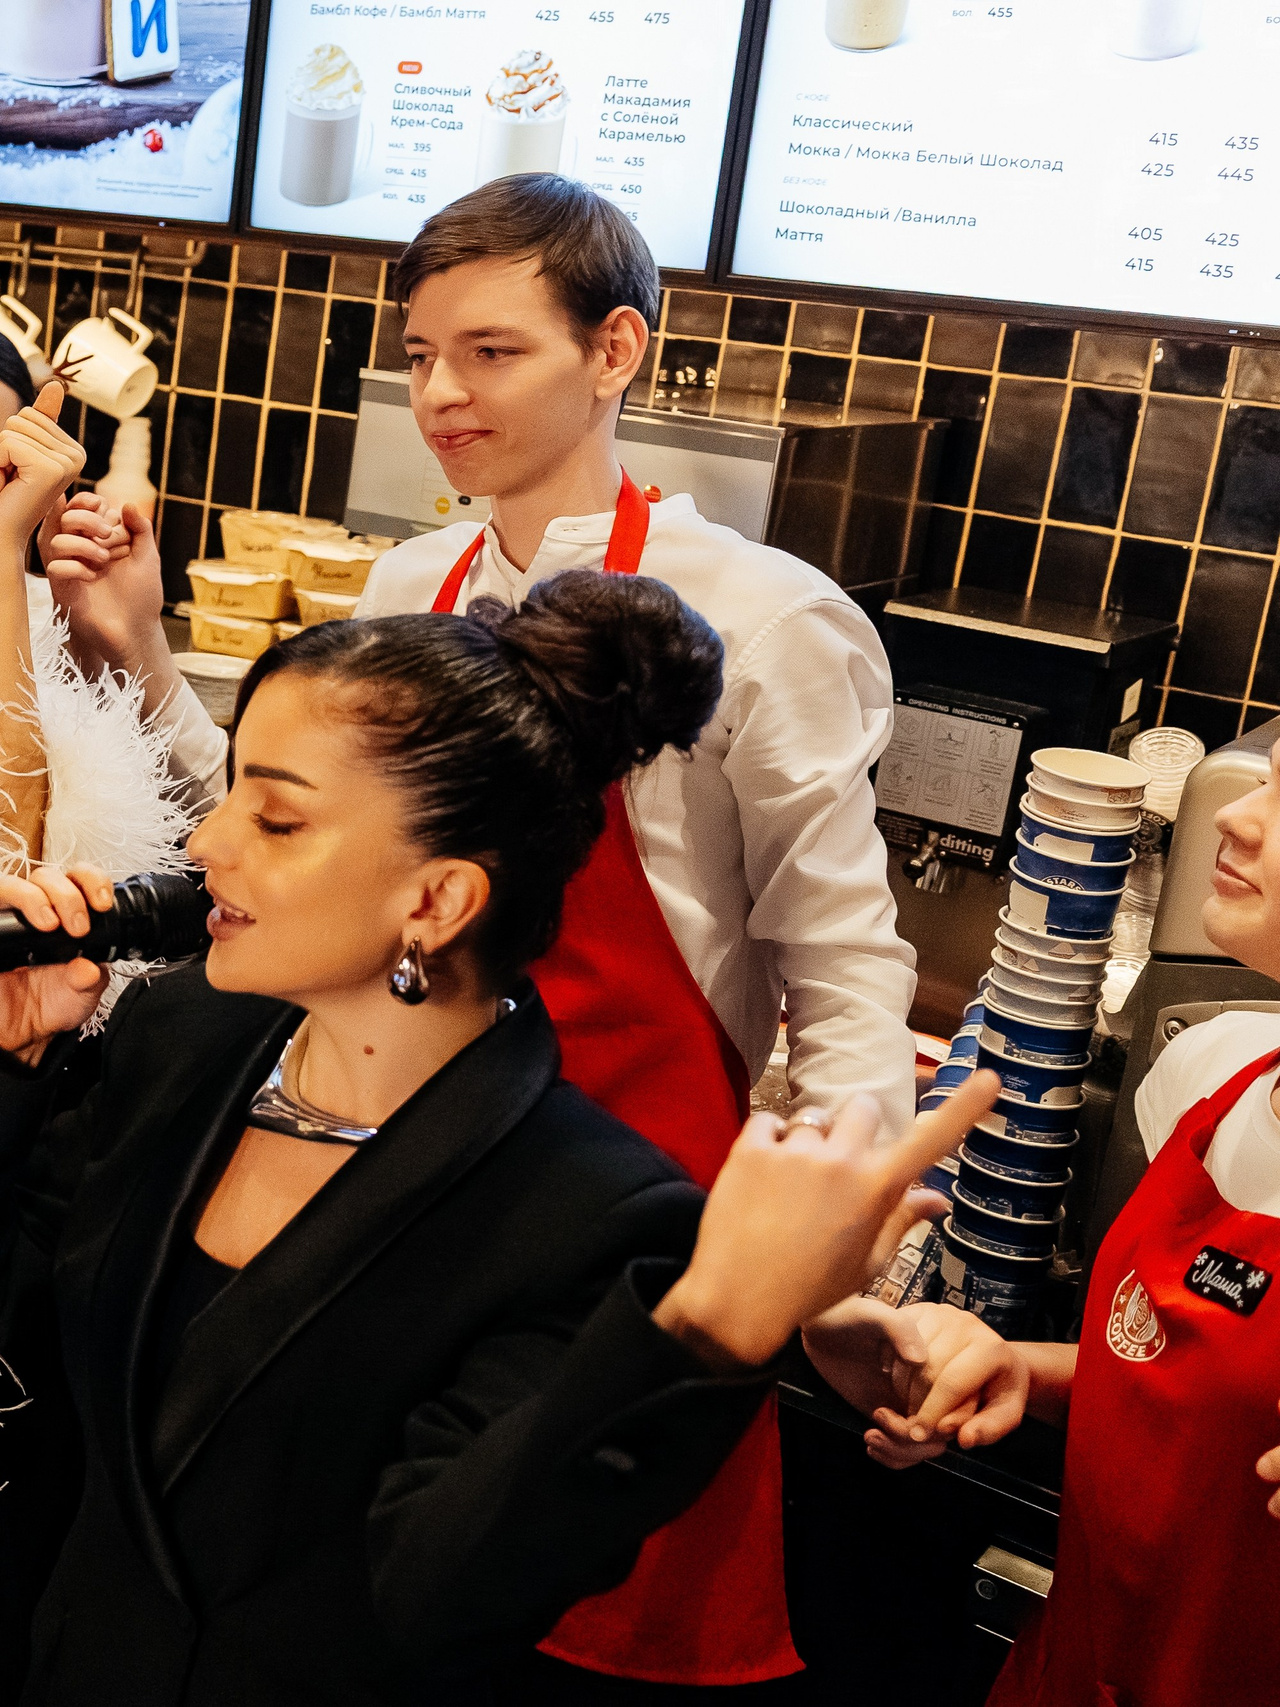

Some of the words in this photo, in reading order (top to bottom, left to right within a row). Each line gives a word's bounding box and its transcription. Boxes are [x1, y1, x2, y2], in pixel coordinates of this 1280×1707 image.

[309, 3, 351, 16] Бамбл
[353, 5, 388, 19] Кофе
[399, 5, 442, 19] Бамбл
[445, 7, 486, 19] Маття
[535, 9, 560, 22] 425
[588, 11, 615, 24] 455
[644, 12, 670, 25] 475
[987, 7, 1013, 18] 455
[131, 0, 168, 58] И
[393, 82, 472, 97] Сливочный
[604, 75, 649, 89] Латте
[392, 99, 454, 114] Шоколад
[603, 93, 691, 108] Макадамия
[390, 115, 464, 131] Крем-Сода
[600, 112, 609, 122] с
[612, 110, 679, 126] Солёной
[598, 127, 686, 144] Карамелью
[792, 114, 913, 133] Классический
[1148, 132, 1179, 147] 415
[1224, 136, 1260, 151] 435
[413, 142, 432, 153] 395
[623, 156, 645, 167] 435
[788, 142, 841, 157] Мокка
[843, 143, 854, 159] /
[856, 146, 910, 162] Мокка
[916, 149, 974, 165] Белый
[980, 153, 1064, 173] Шоколад
[1140, 162, 1175, 177] 425
[1217, 167, 1254, 182] 445
[410, 168, 427, 178] 415
[620, 184, 642, 195] 450
[407, 194, 426, 204] 435
[779, 200, 890, 220] Шоколадный
[1127, 226, 1163, 242] 405
[1204, 232, 1240, 248] 425
[775, 227, 824, 243] Маття
[1124, 257, 1154, 272] 415
[1199, 263, 1234, 279] 435
[908, 698, 950, 713] OPERATING
[951, 707, 1007, 725] INSTRUCTIONS
[939, 834, 995, 862] ditting
[1111, 1312, 1147, 1357] COFFEE
